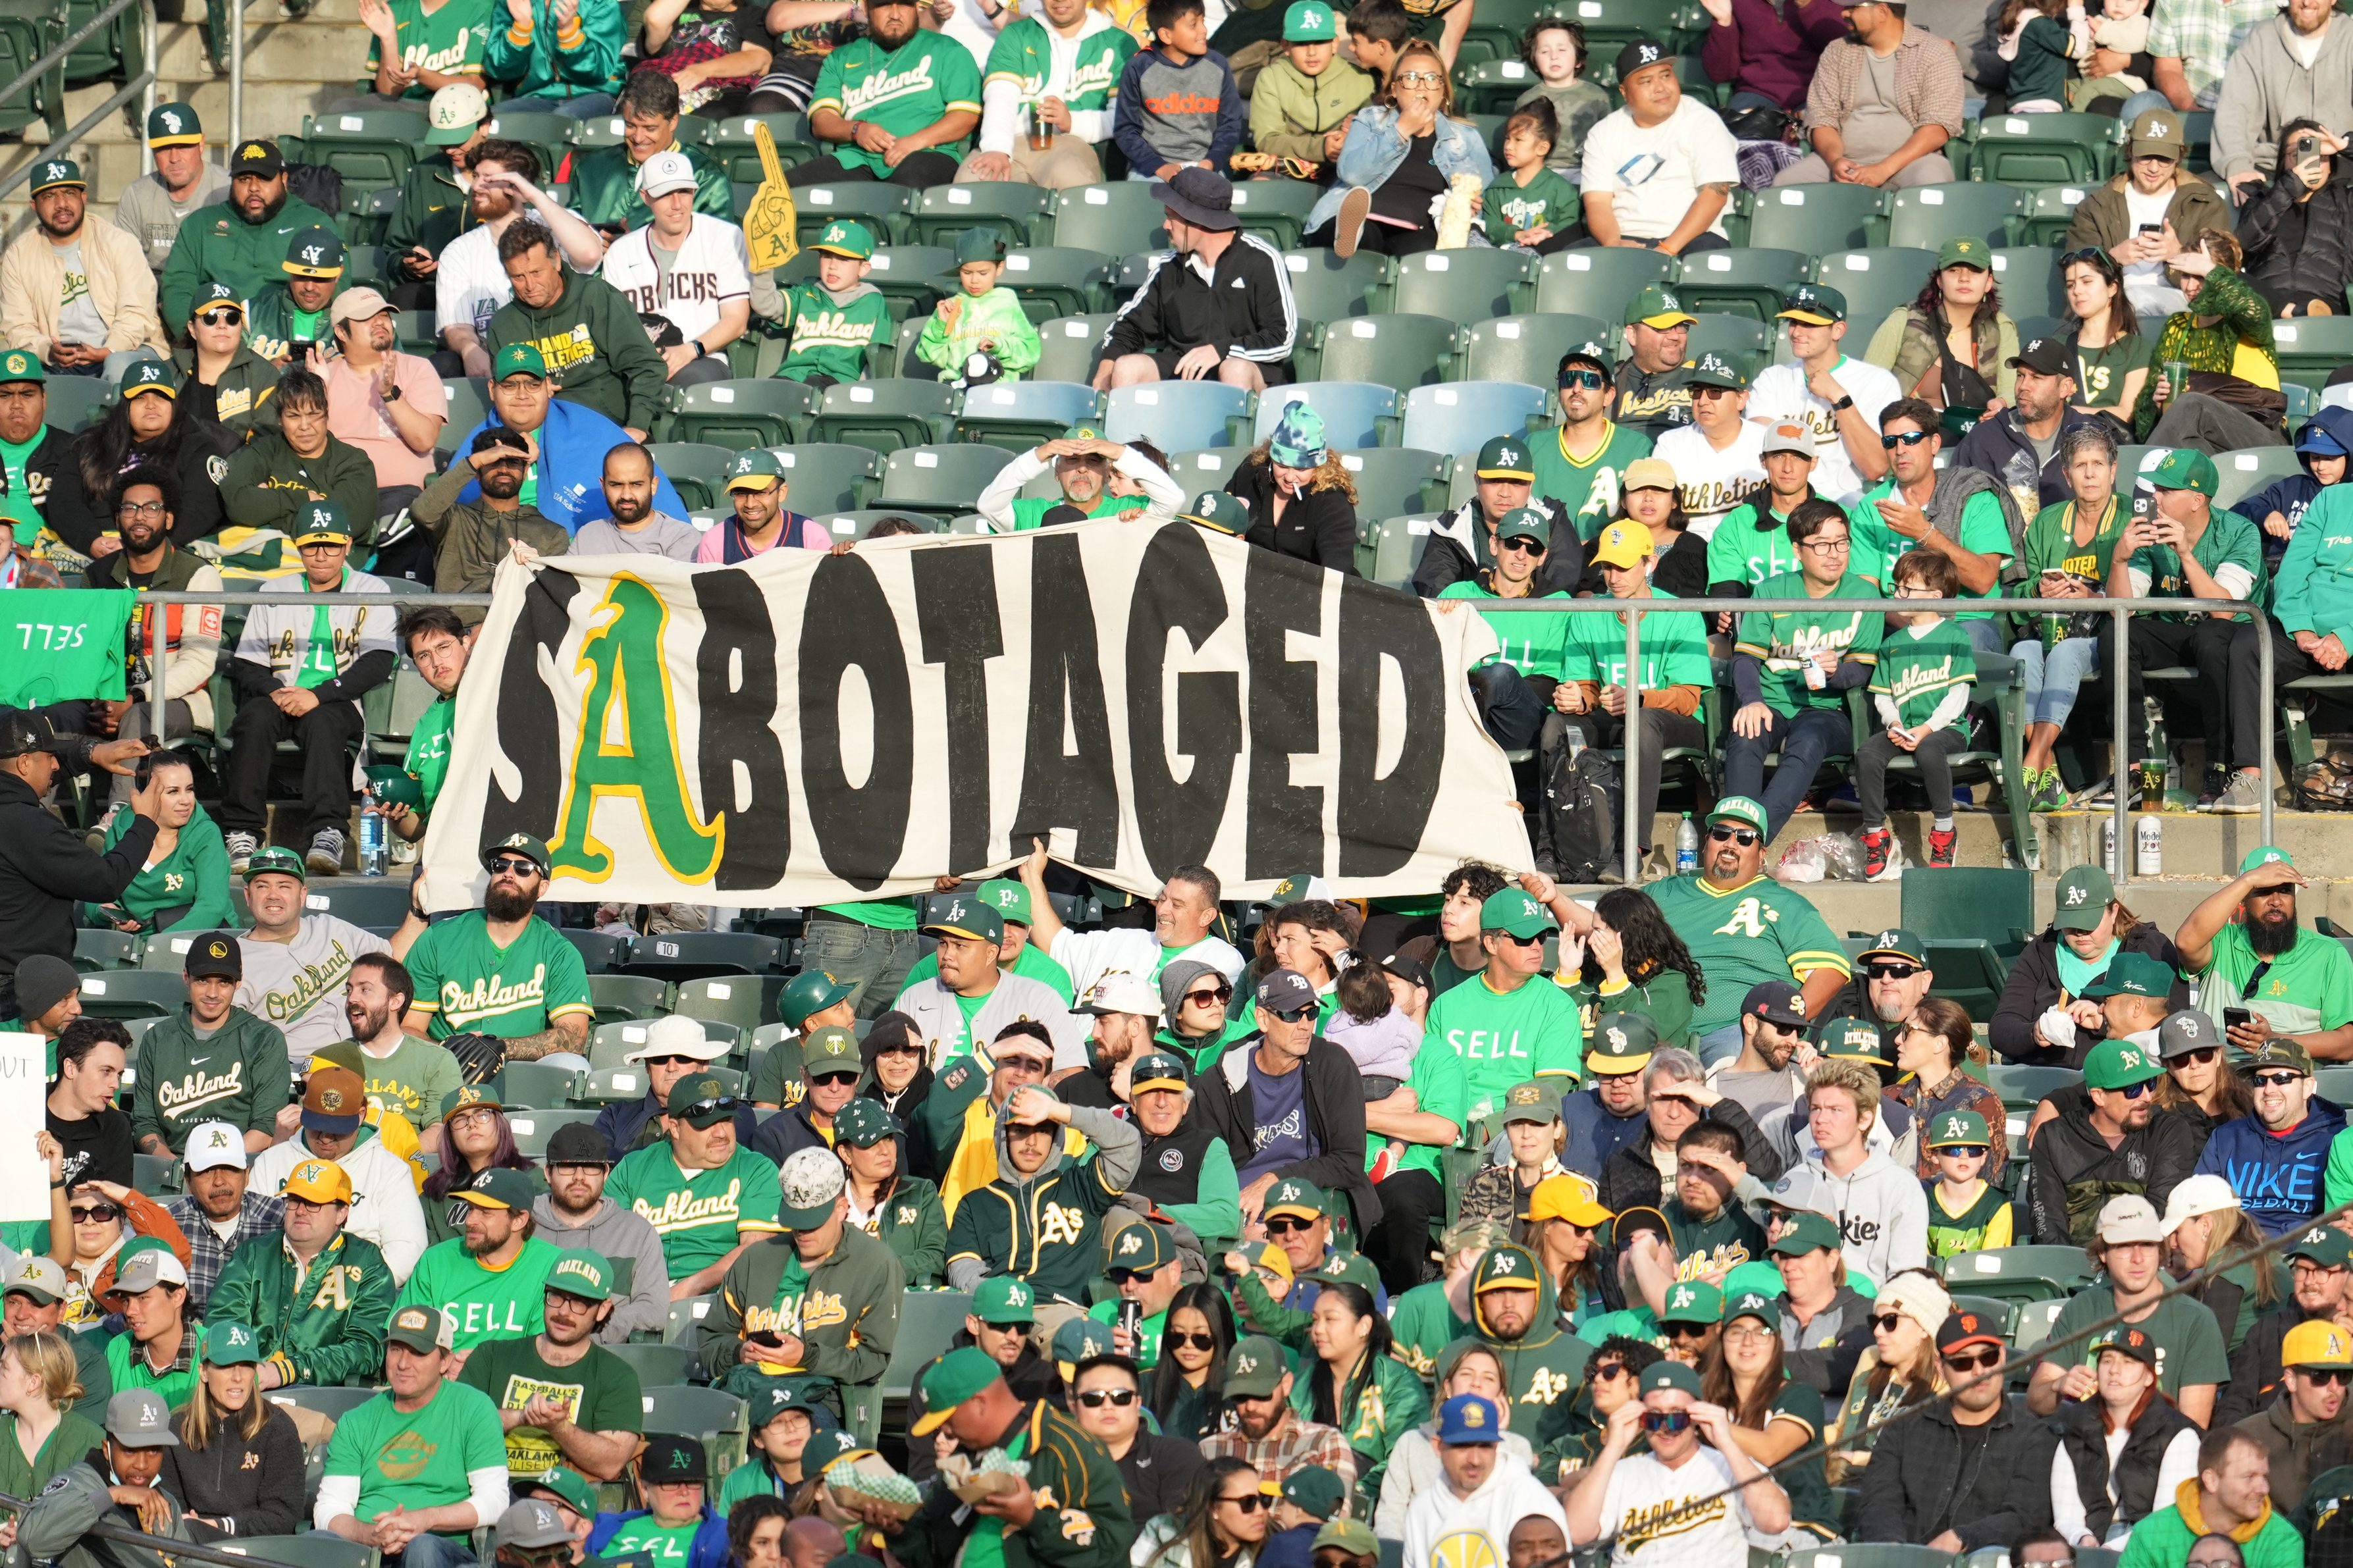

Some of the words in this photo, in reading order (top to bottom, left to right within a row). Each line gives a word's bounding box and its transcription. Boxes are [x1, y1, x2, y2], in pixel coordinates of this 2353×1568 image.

[438, 107, 456, 124] A's
[1145, 91, 1219, 113] adidas
[46, 162, 66, 180] A's
[766, 232, 790, 259] A's
[211, 284, 230, 300] A's
[795, 311, 875, 342] Oakland
[16, 623, 88, 650] SELL
[1890, 654, 1952, 697] Oakland
[479, 521, 1446, 891] SABOTAGED
[2142, 770, 2161, 789] A's
[1718, 797, 1760, 822] OAKLAND
[2140, 830, 2161, 841] Model
[314, 897, 322, 908] 7
[1712, 897, 1780, 937] A's
[662, 943, 674, 956] 10
[265, 939, 352, 1020] Oakland
[442, 964, 545, 1010] Oakland
[1287, 974, 1308, 990] TB
[1446, 1029, 1529, 1059] SELL
[159, 1062, 242, 1107] Oakland
[2226, 1159, 2317, 1199] NIKE
[632, 1179, 741, 1228] Oakland
[1040, 1202, 1084, 1247] A's
[556, 1259, 602, 1288] OAKLAND
[442, 1299, 524, 1332] SELL
[513, 1378, 579, 1395] BASEBALL'S
[1520, 1367, 1568, 1406] A's
